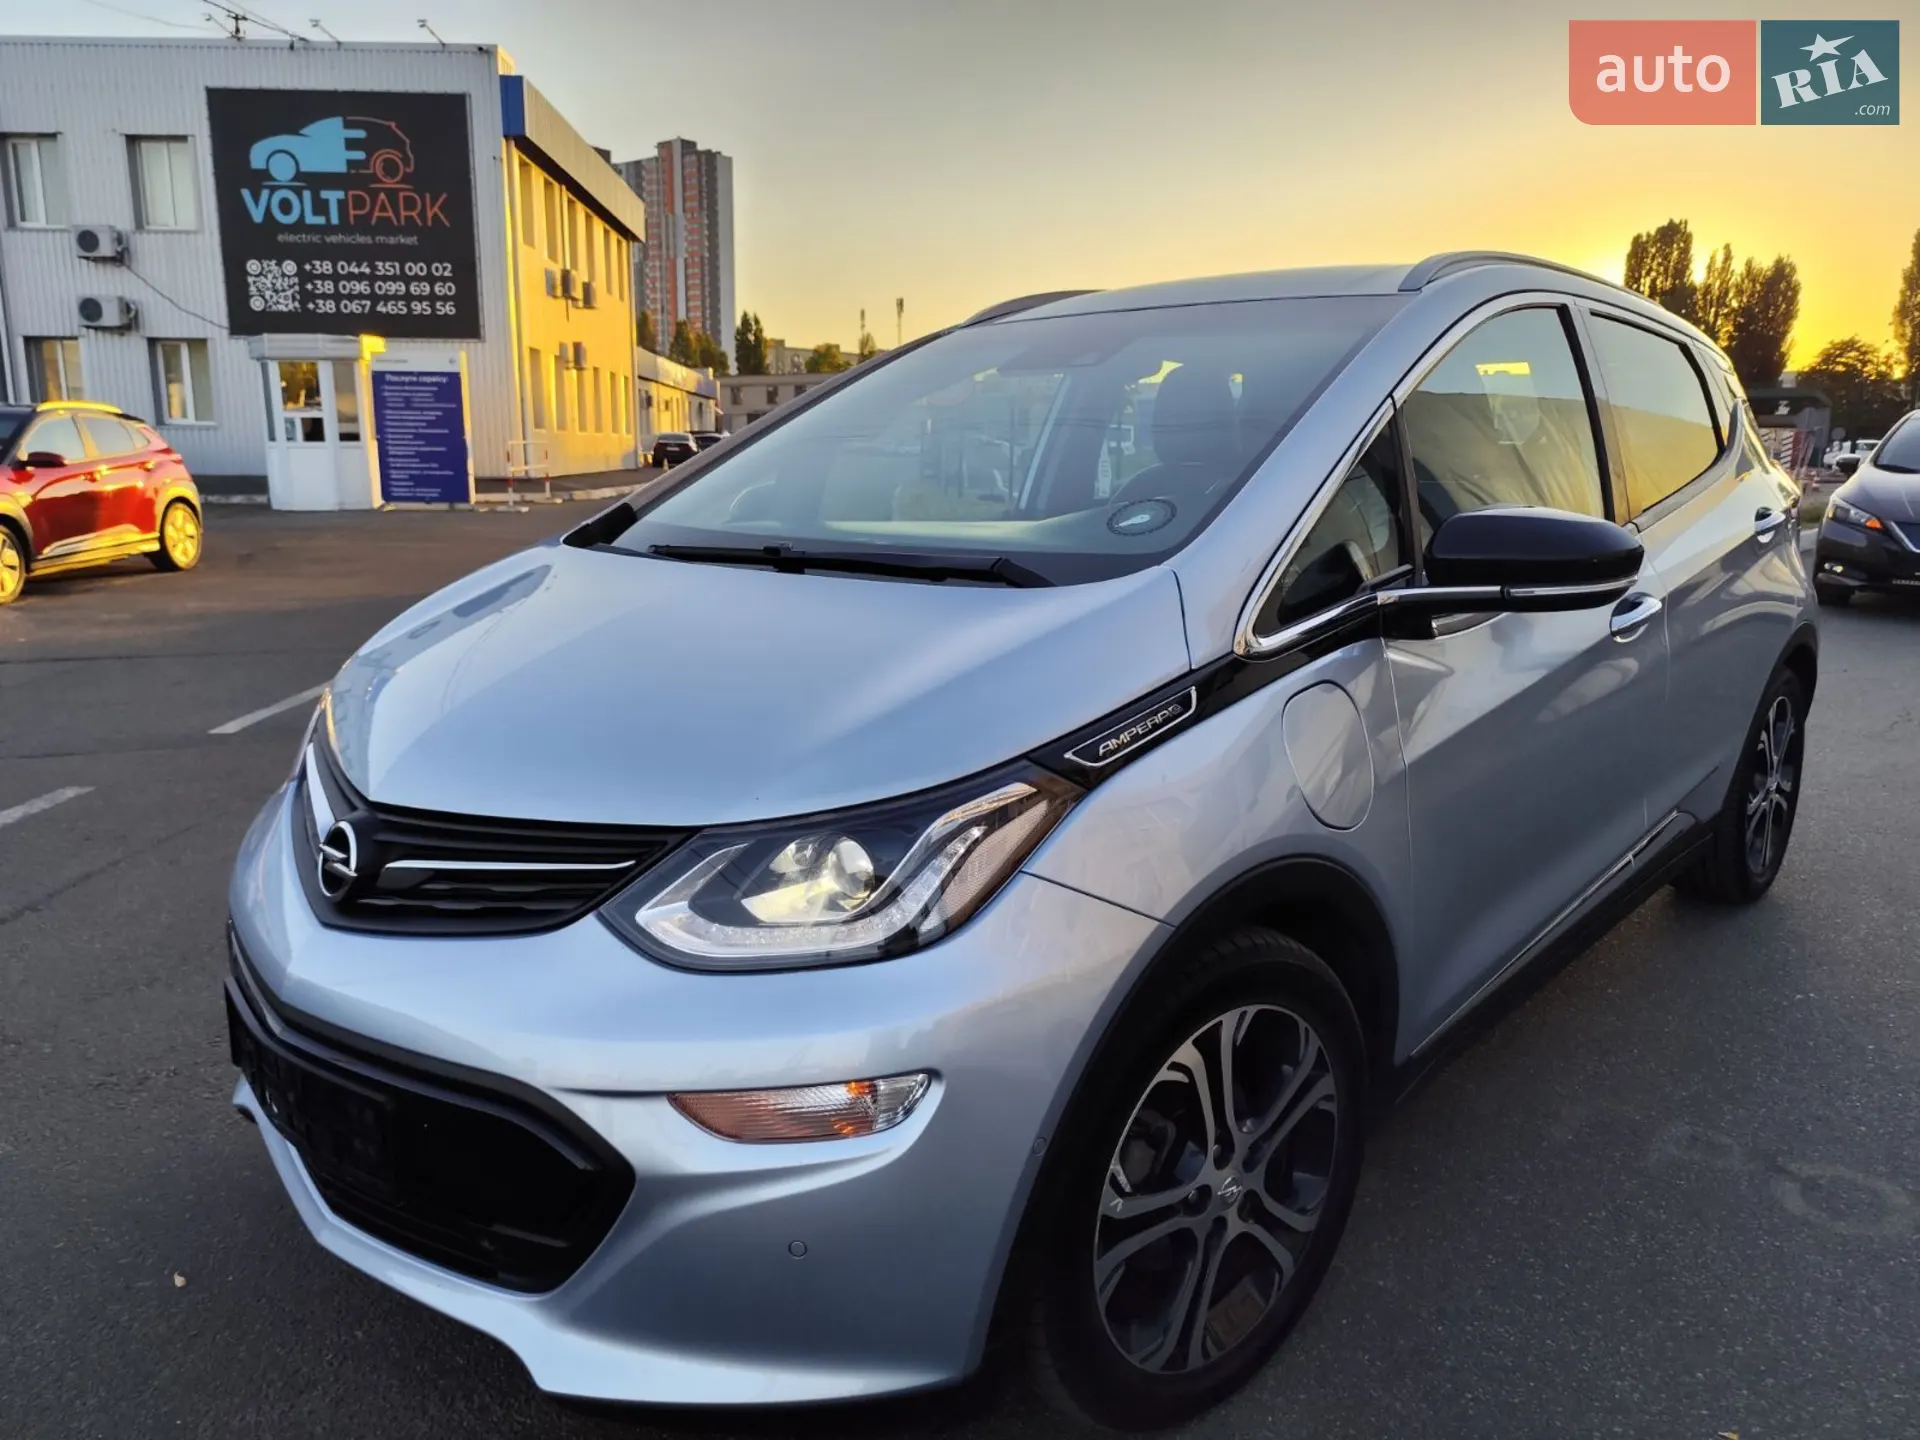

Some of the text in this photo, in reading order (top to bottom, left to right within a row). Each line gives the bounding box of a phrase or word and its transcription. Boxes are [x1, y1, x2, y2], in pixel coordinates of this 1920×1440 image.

[240, 188, 450, 227] VOLTPARK
[277, 232, 419, 245] electric vehicles market
[303, 260, 453, 277] +38 044 351 00 02
[304, 280, 456, 296] +38 096 099 69 60
[306, 299, 456, 316] +38 067 465 95 56
